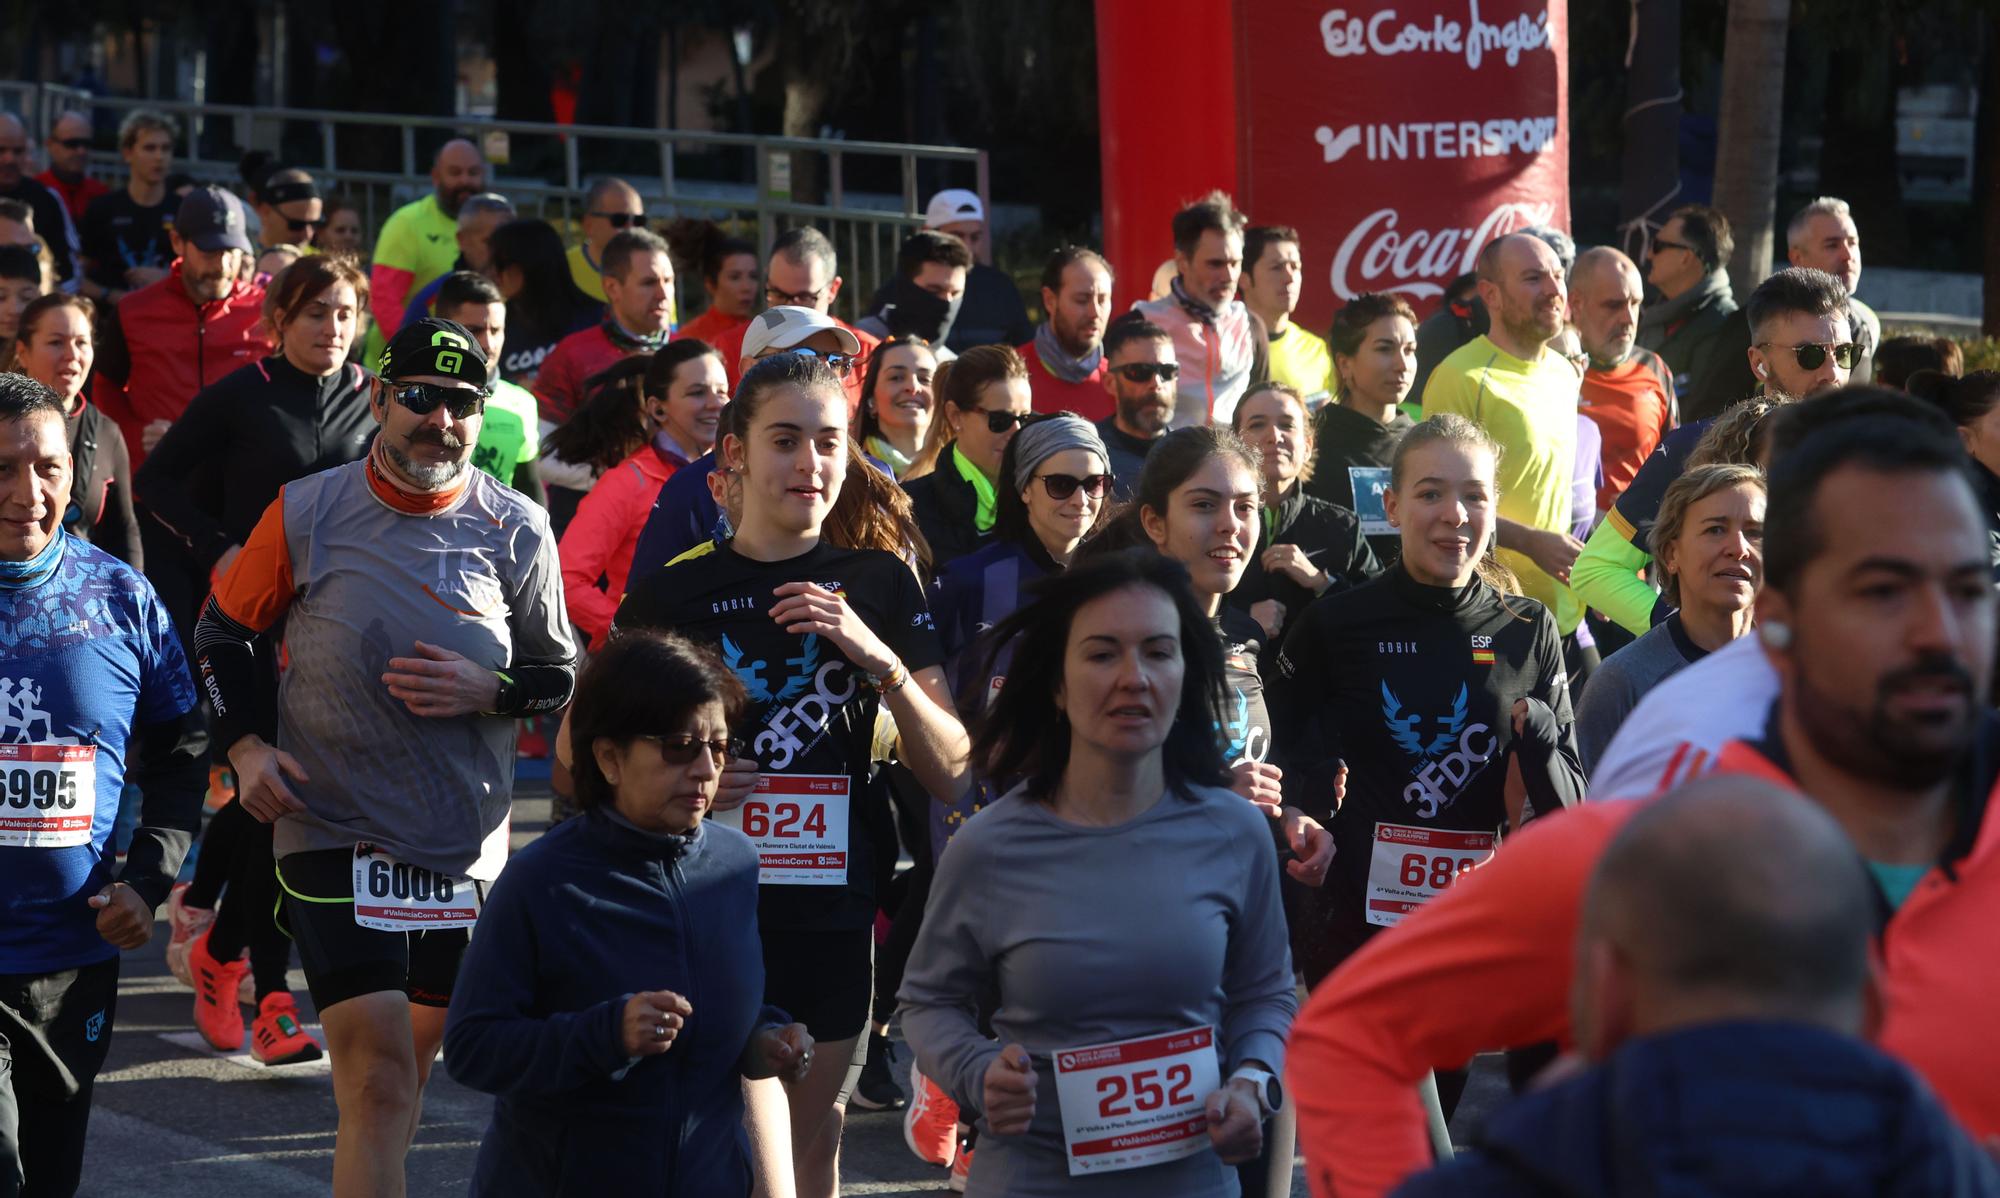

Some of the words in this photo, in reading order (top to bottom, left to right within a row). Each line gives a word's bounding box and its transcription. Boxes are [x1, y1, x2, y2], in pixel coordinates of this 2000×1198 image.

[1320, 9, 1366, 57] El
[1367, 9, 1461, 55] Corte
[1466, 0, 1555, 69] Inglés
[1366, 116, 1556, 161] INTERSPORT
[712, 596, 755, 614] GOBIK
[1378, 641, 1417, 654] GOBIK
[1471, 635, 1493, 648] ESP
[205, 674, 227, 717] BIONIC
[753, 660, 856, 770] 3FDC
[1403, 722, 1498, 819] 3FDC
[742, 802, 827, 839] 624
[760, 857, 813, 866] alènciaCorre
[368, 860, 454, 903] 6006
[1384, 887, 1400, 895] Volta
[383, 908, 439, 919] #ValènciaCorre
[1096, 1063, 1195, 1118] 252
[1111, 1128, 1185, 1148] #ValènciaCorre
